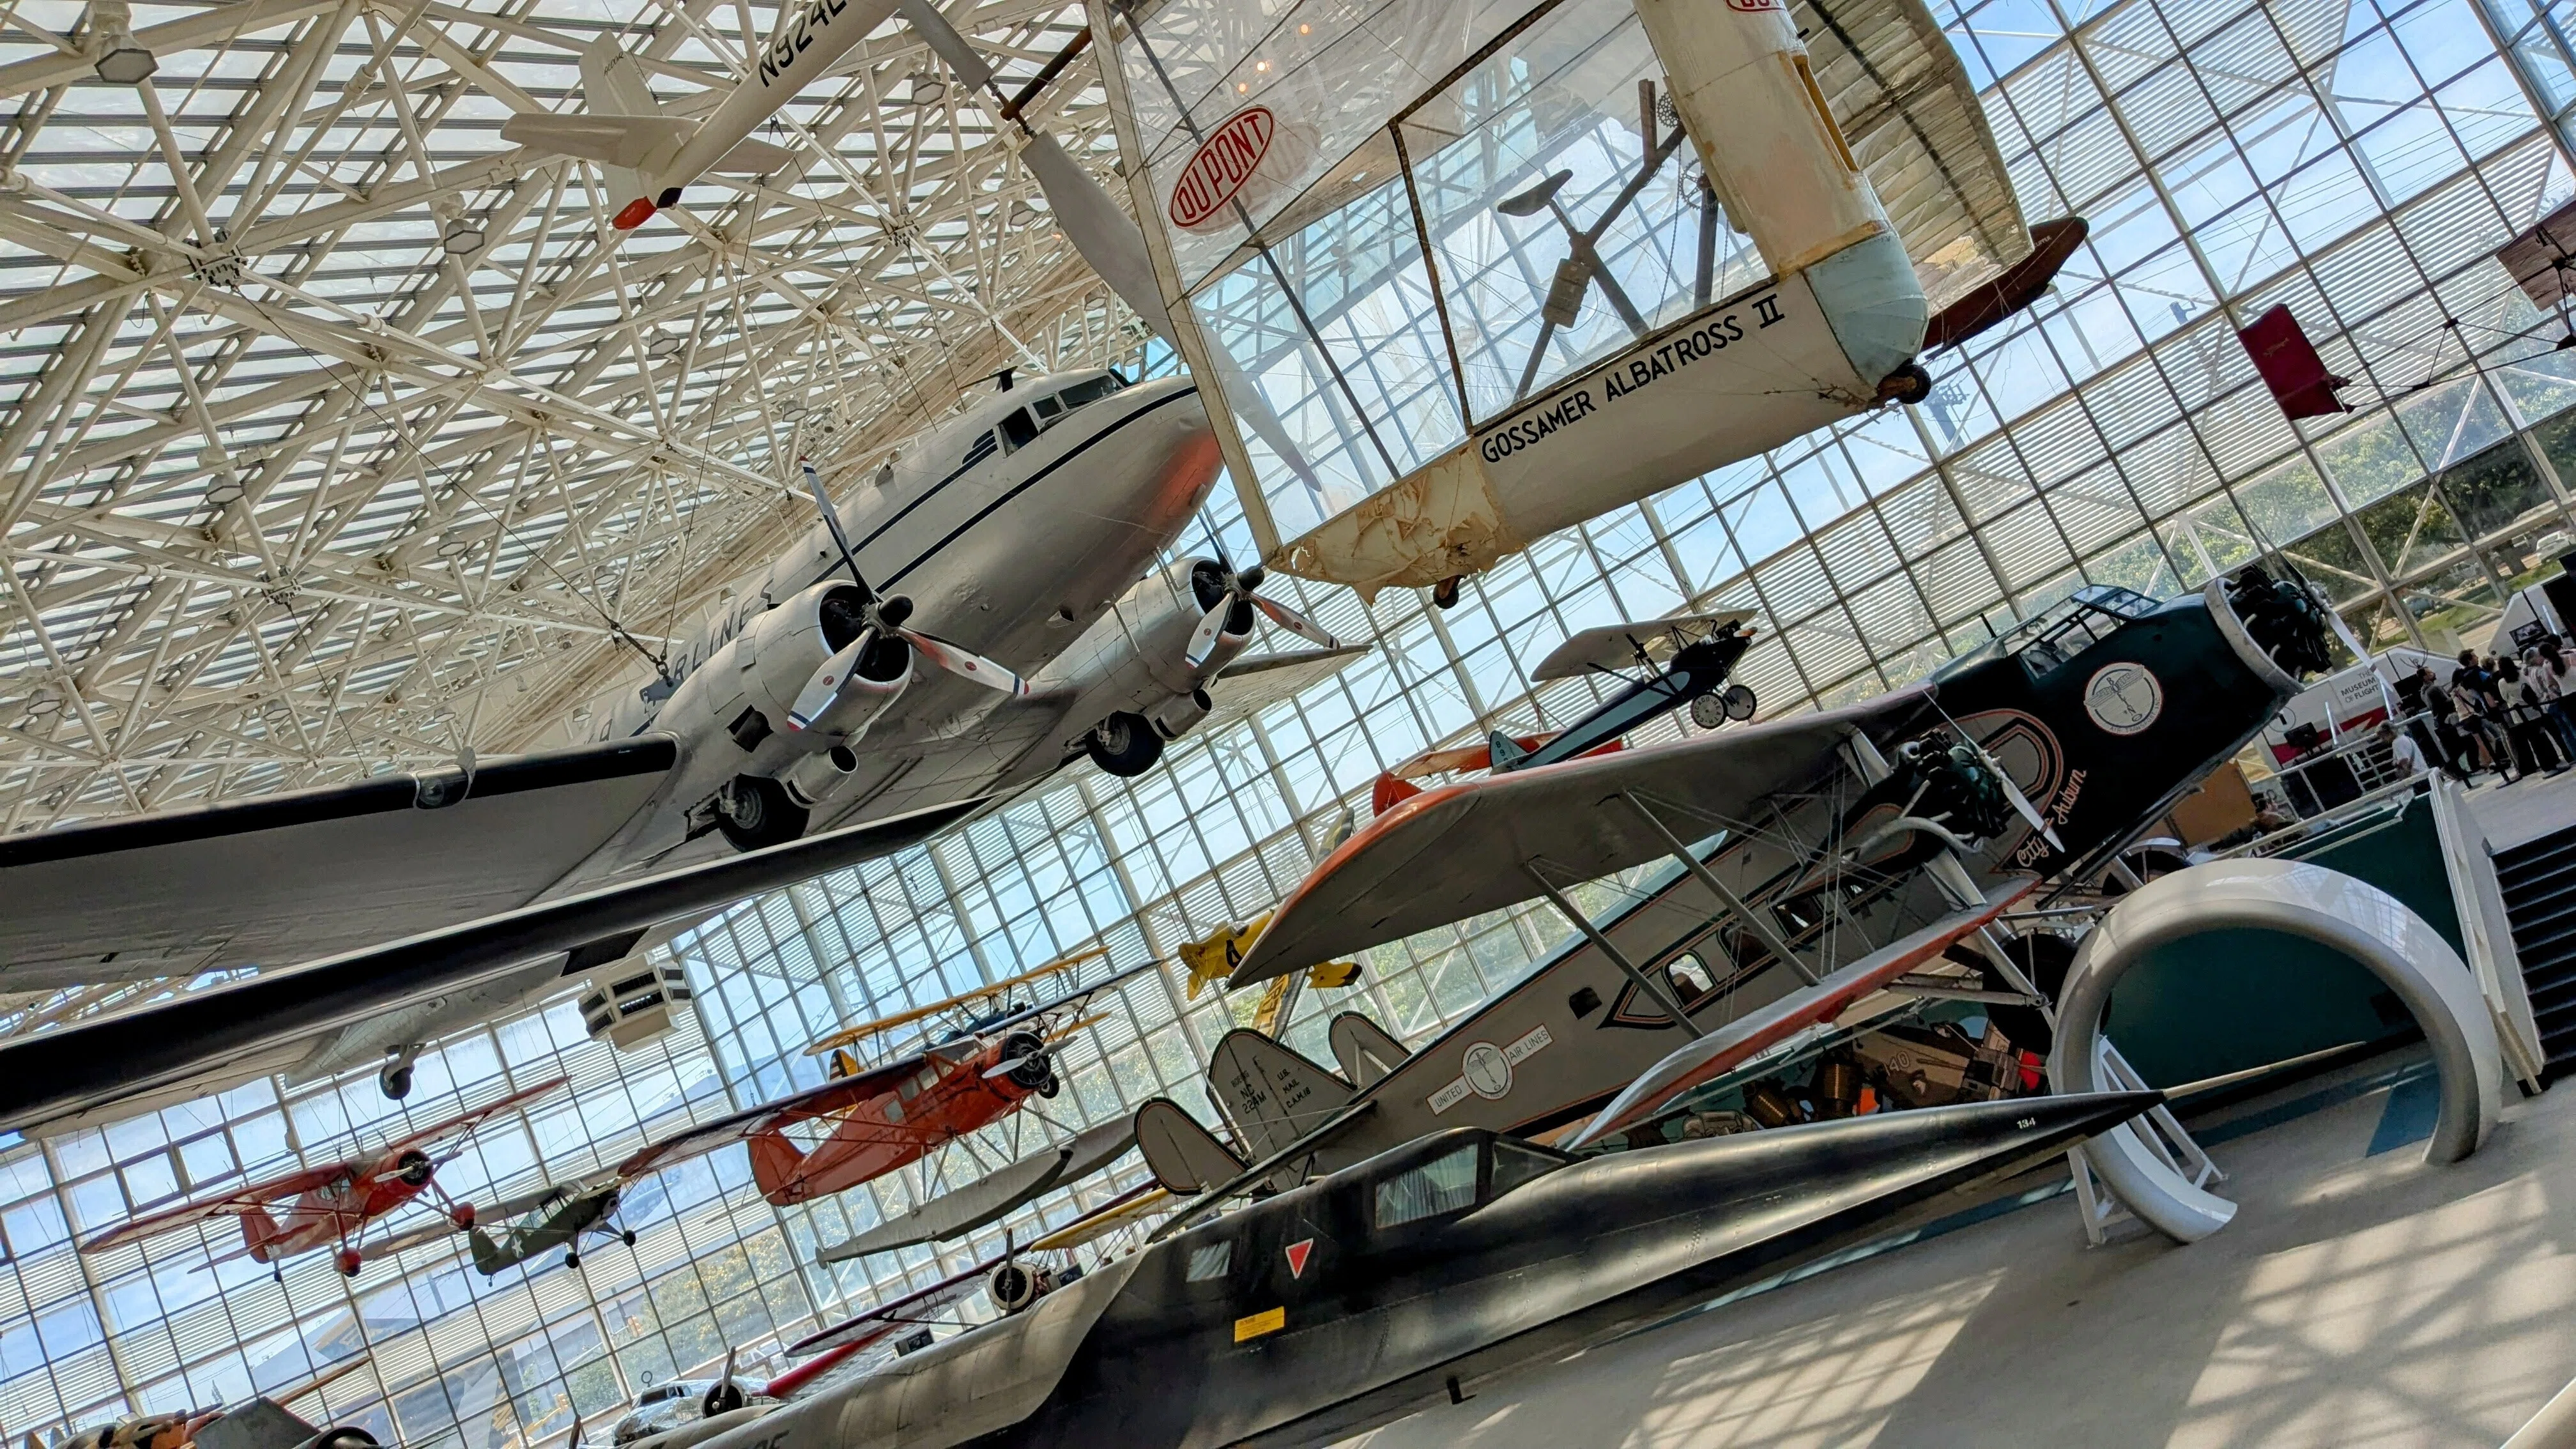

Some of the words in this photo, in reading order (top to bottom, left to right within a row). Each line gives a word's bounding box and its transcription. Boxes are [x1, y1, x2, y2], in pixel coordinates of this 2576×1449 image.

[604, 51, 624, 76] ALCOR
[1482, 390, 1597, 463] GOSSAMER
[1606, 314, 1744, 402] ALBATROSS
[1752, 293, 1785, 330] II
[2358, 670, 2372, 678] THE
[2341, 677, 2376, 696] MUSEUM
[2354, 684, 2379, 700] FLIGHT
[2016, 836, 2049, 868] City
[2052, 769, 2087, 825] Auburn
[1435, 1085, 1462, 1107] UNITED
[1508, 1046, 1524, 1061] AIR
[1524, 1030, 1549, 1050] LINES
[1240, 1084, 1255, 1099] NC
[1283, 1078, 1300, 1094] MAIL
[1242, 1091, 1266, 1114] 224M
